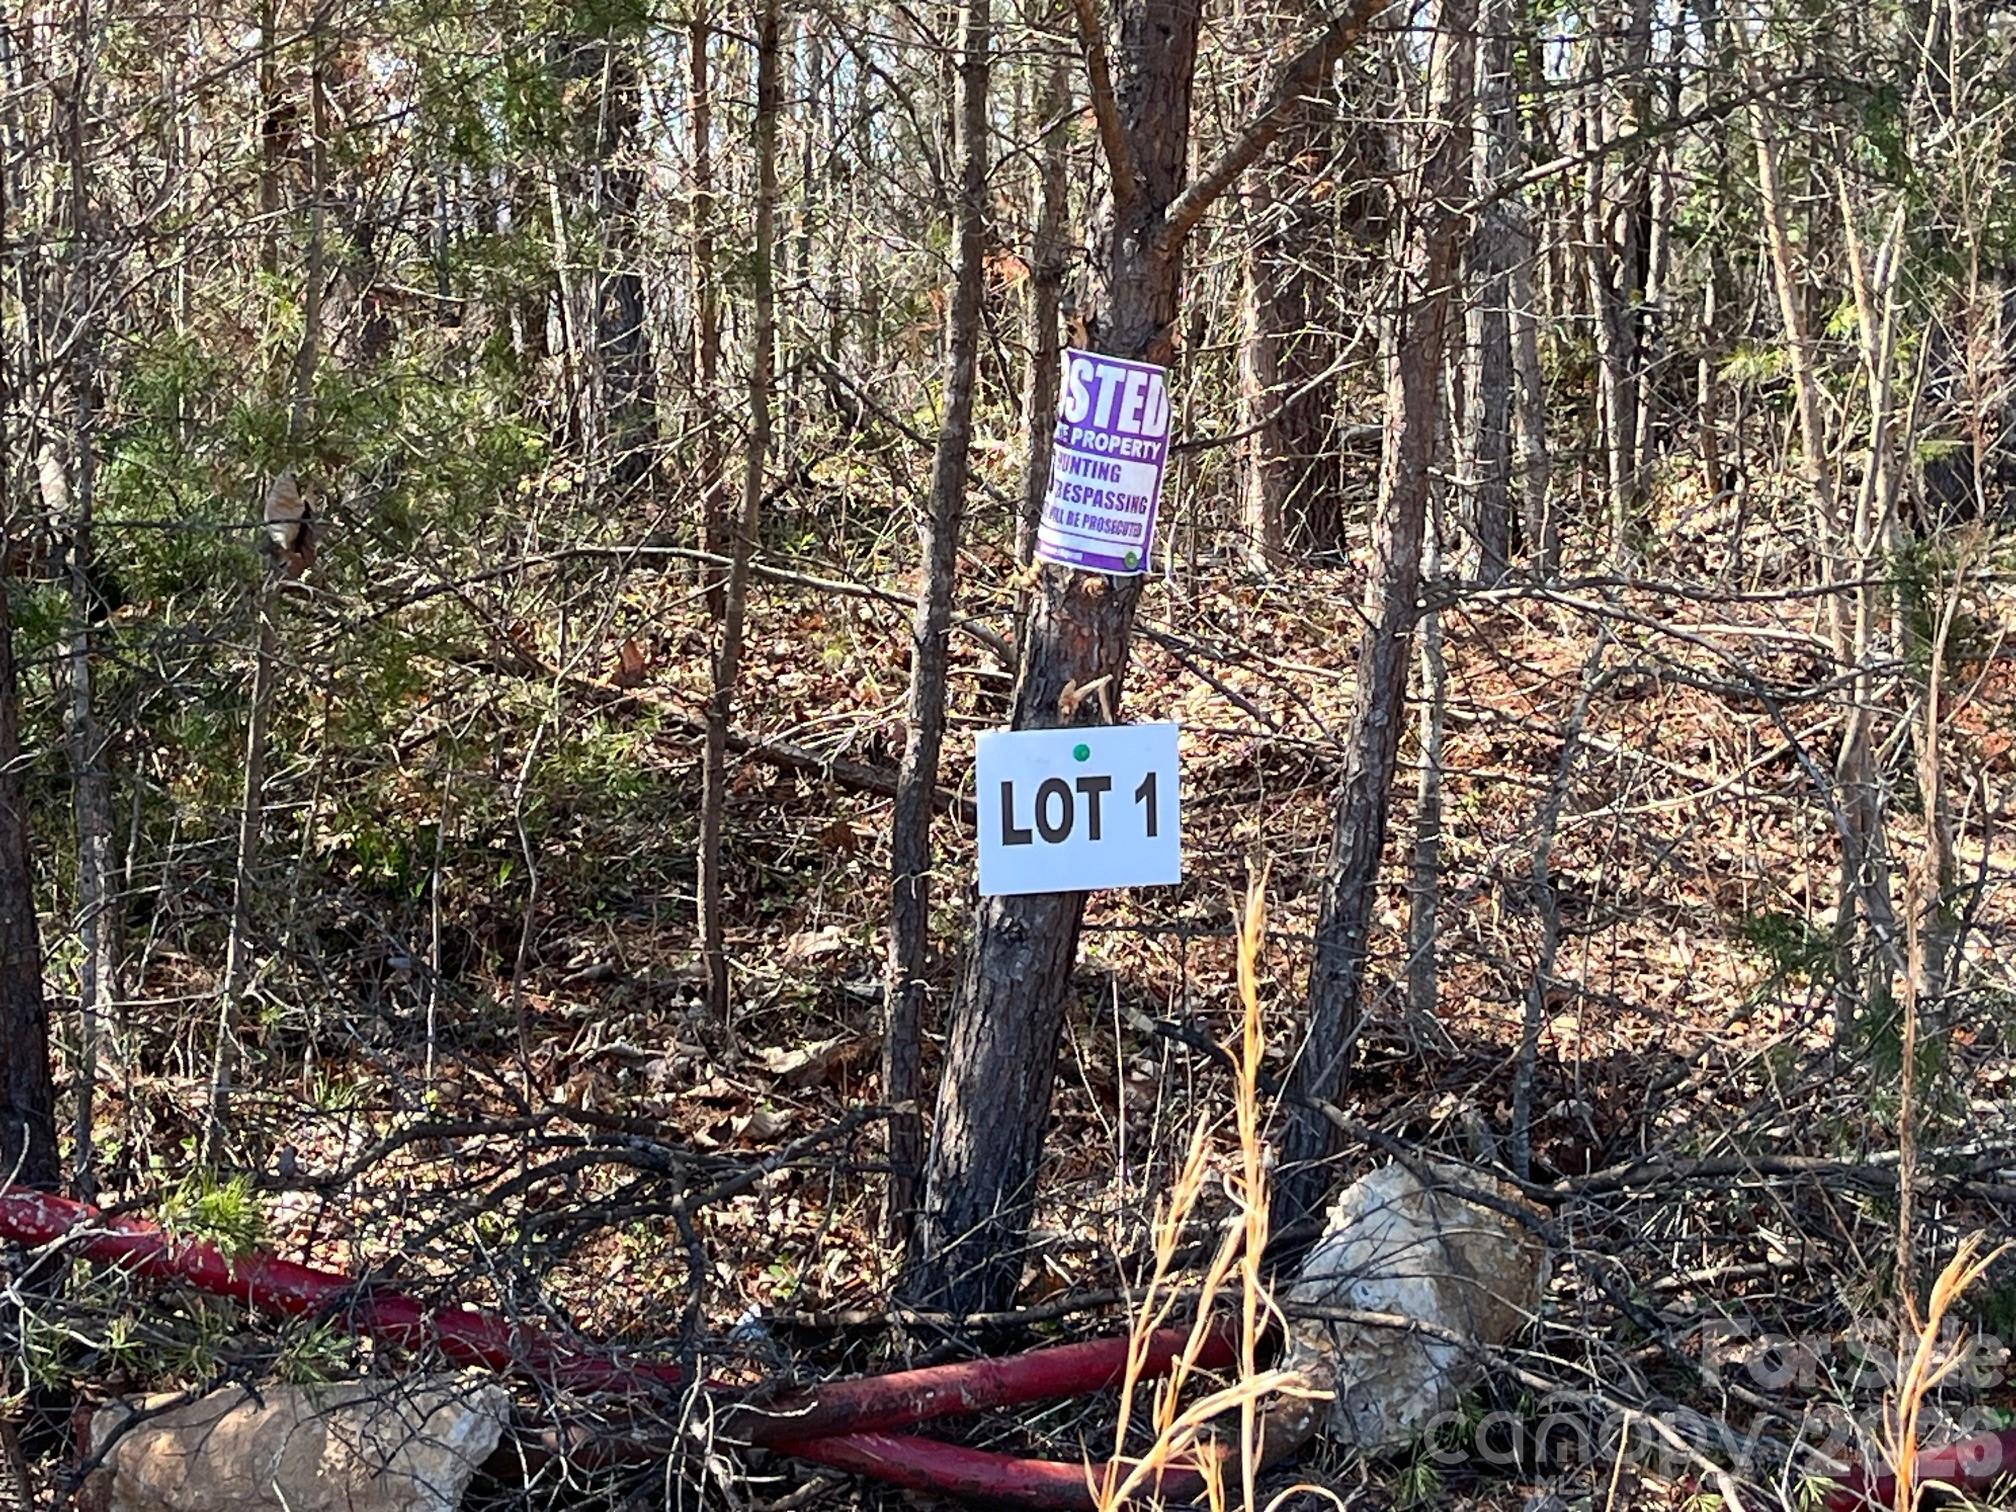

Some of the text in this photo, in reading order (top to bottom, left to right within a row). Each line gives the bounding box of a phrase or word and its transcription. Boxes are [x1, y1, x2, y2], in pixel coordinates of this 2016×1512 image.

[1071, 427, 1162, 460] PROPERTY
[1054, 477, 1148, 515] RESPASSING
[1065, 510, 1081, 529] BE
[1000, 771, 1158, 846] LOT 1
